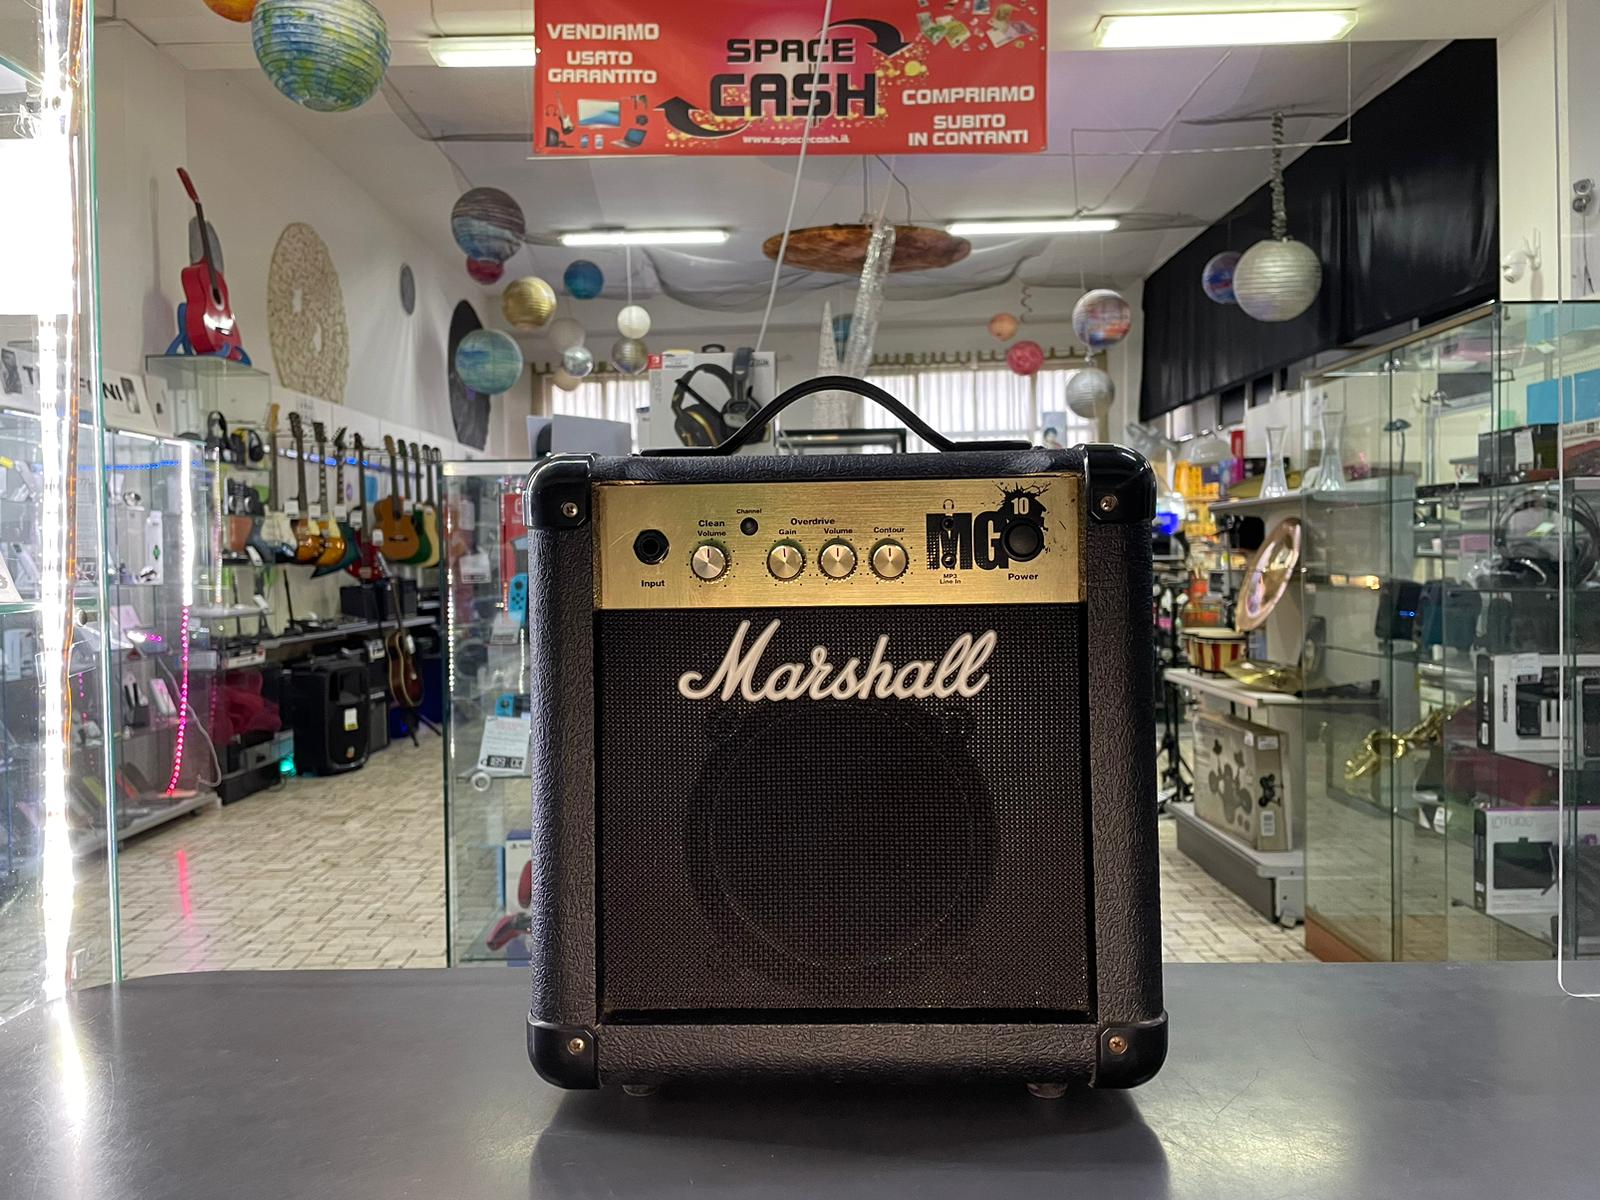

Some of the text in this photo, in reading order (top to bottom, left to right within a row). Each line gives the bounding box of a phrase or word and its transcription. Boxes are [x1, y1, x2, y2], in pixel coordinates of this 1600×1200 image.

[546, 23, 660, 42] VENDIAMO
[566, 50, 633, 67] USATO
[726, 38, 855, 63] SPACE
[547, 66, 657, 84] GARANTITO
[902, 86, 1035, 105] COMPRIAMO
[933, 113, 1006, 130] SUBITO
[908, 130, 1029, 146] IN CONTANTI
[1011, 497, 1030, 515] 10
[698, 519, 725, 528] Clean
[790, 517, 835, 526] Overdrive
[697, 530, 727, 538] Volume
[778, 528, 797, 536] Gain
[823, 527, 853, 535] Volume
[873, 526, 905, 534] Contour
[926, 511, 1009, 570] MG
[641, 579, 665, 588] Input
[1008, 573, 1039, 581] Power
[678, 619, 997, 702] Marshall
